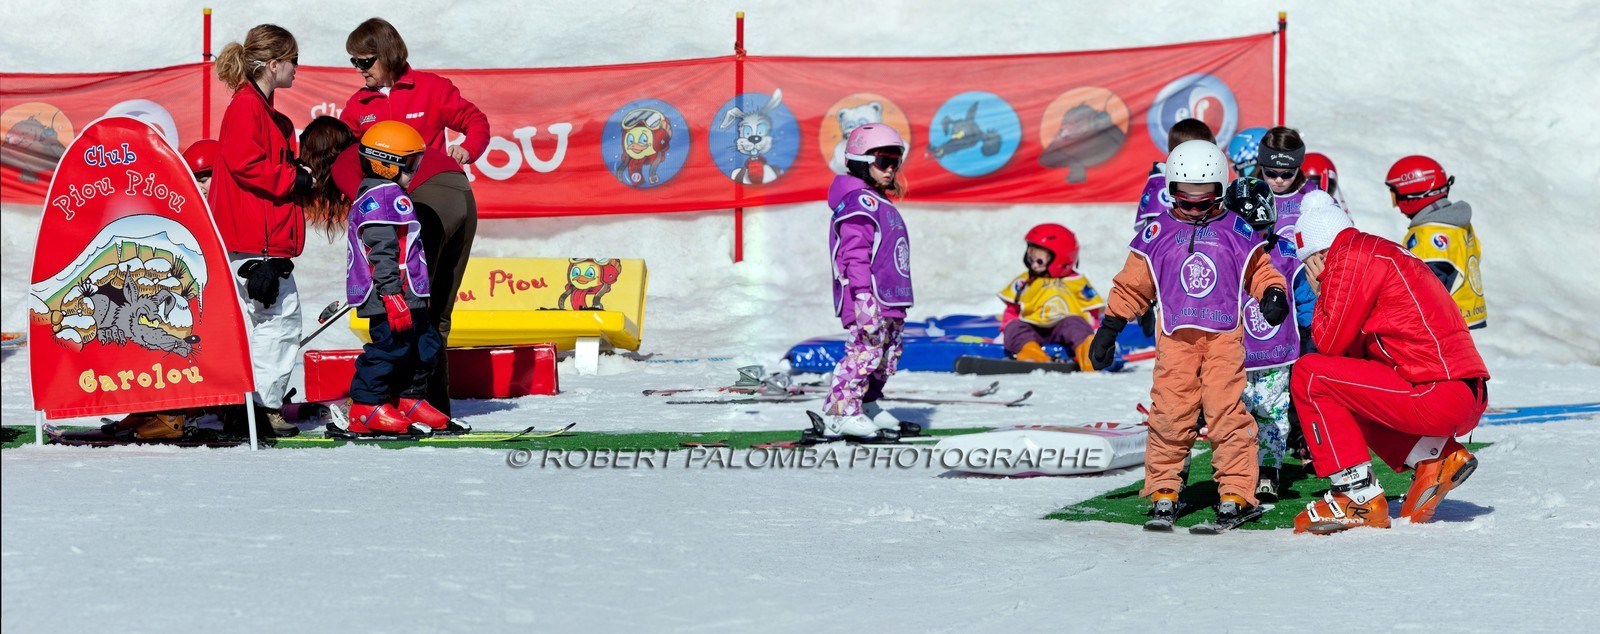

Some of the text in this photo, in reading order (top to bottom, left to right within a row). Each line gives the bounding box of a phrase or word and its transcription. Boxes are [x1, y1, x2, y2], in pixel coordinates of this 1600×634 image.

[84, 143, 137, 168] Club
[364, 147, 403, 162] SCOTT
[52, 169, 186, 221] Piou Piou
[489, 269, 549, 298] Piou
[78, 363, 204, 393] Garolou
